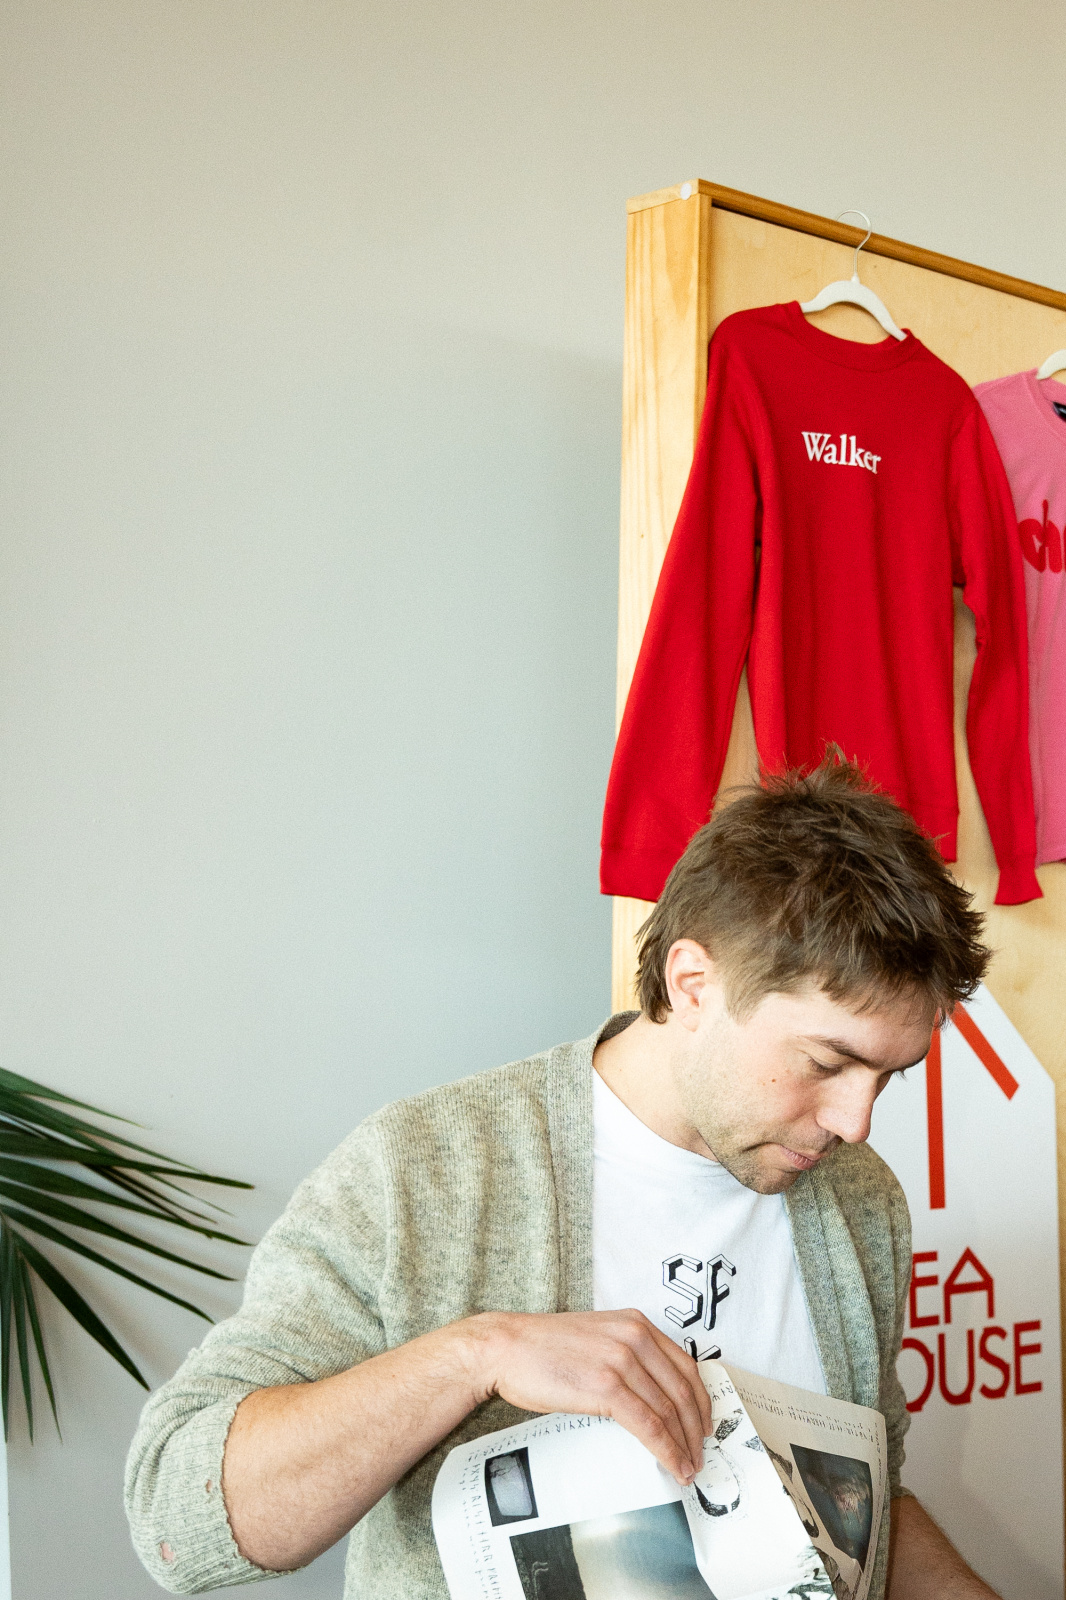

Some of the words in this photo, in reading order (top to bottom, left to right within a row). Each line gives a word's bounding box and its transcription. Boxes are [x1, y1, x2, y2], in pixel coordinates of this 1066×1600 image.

[802, 431, 881, 474] Walker
[662, 1253, 737, 1331] SF
[909, 1246, 995, 1329] EA
[901, 1320, 1043, 1412] OUSE
